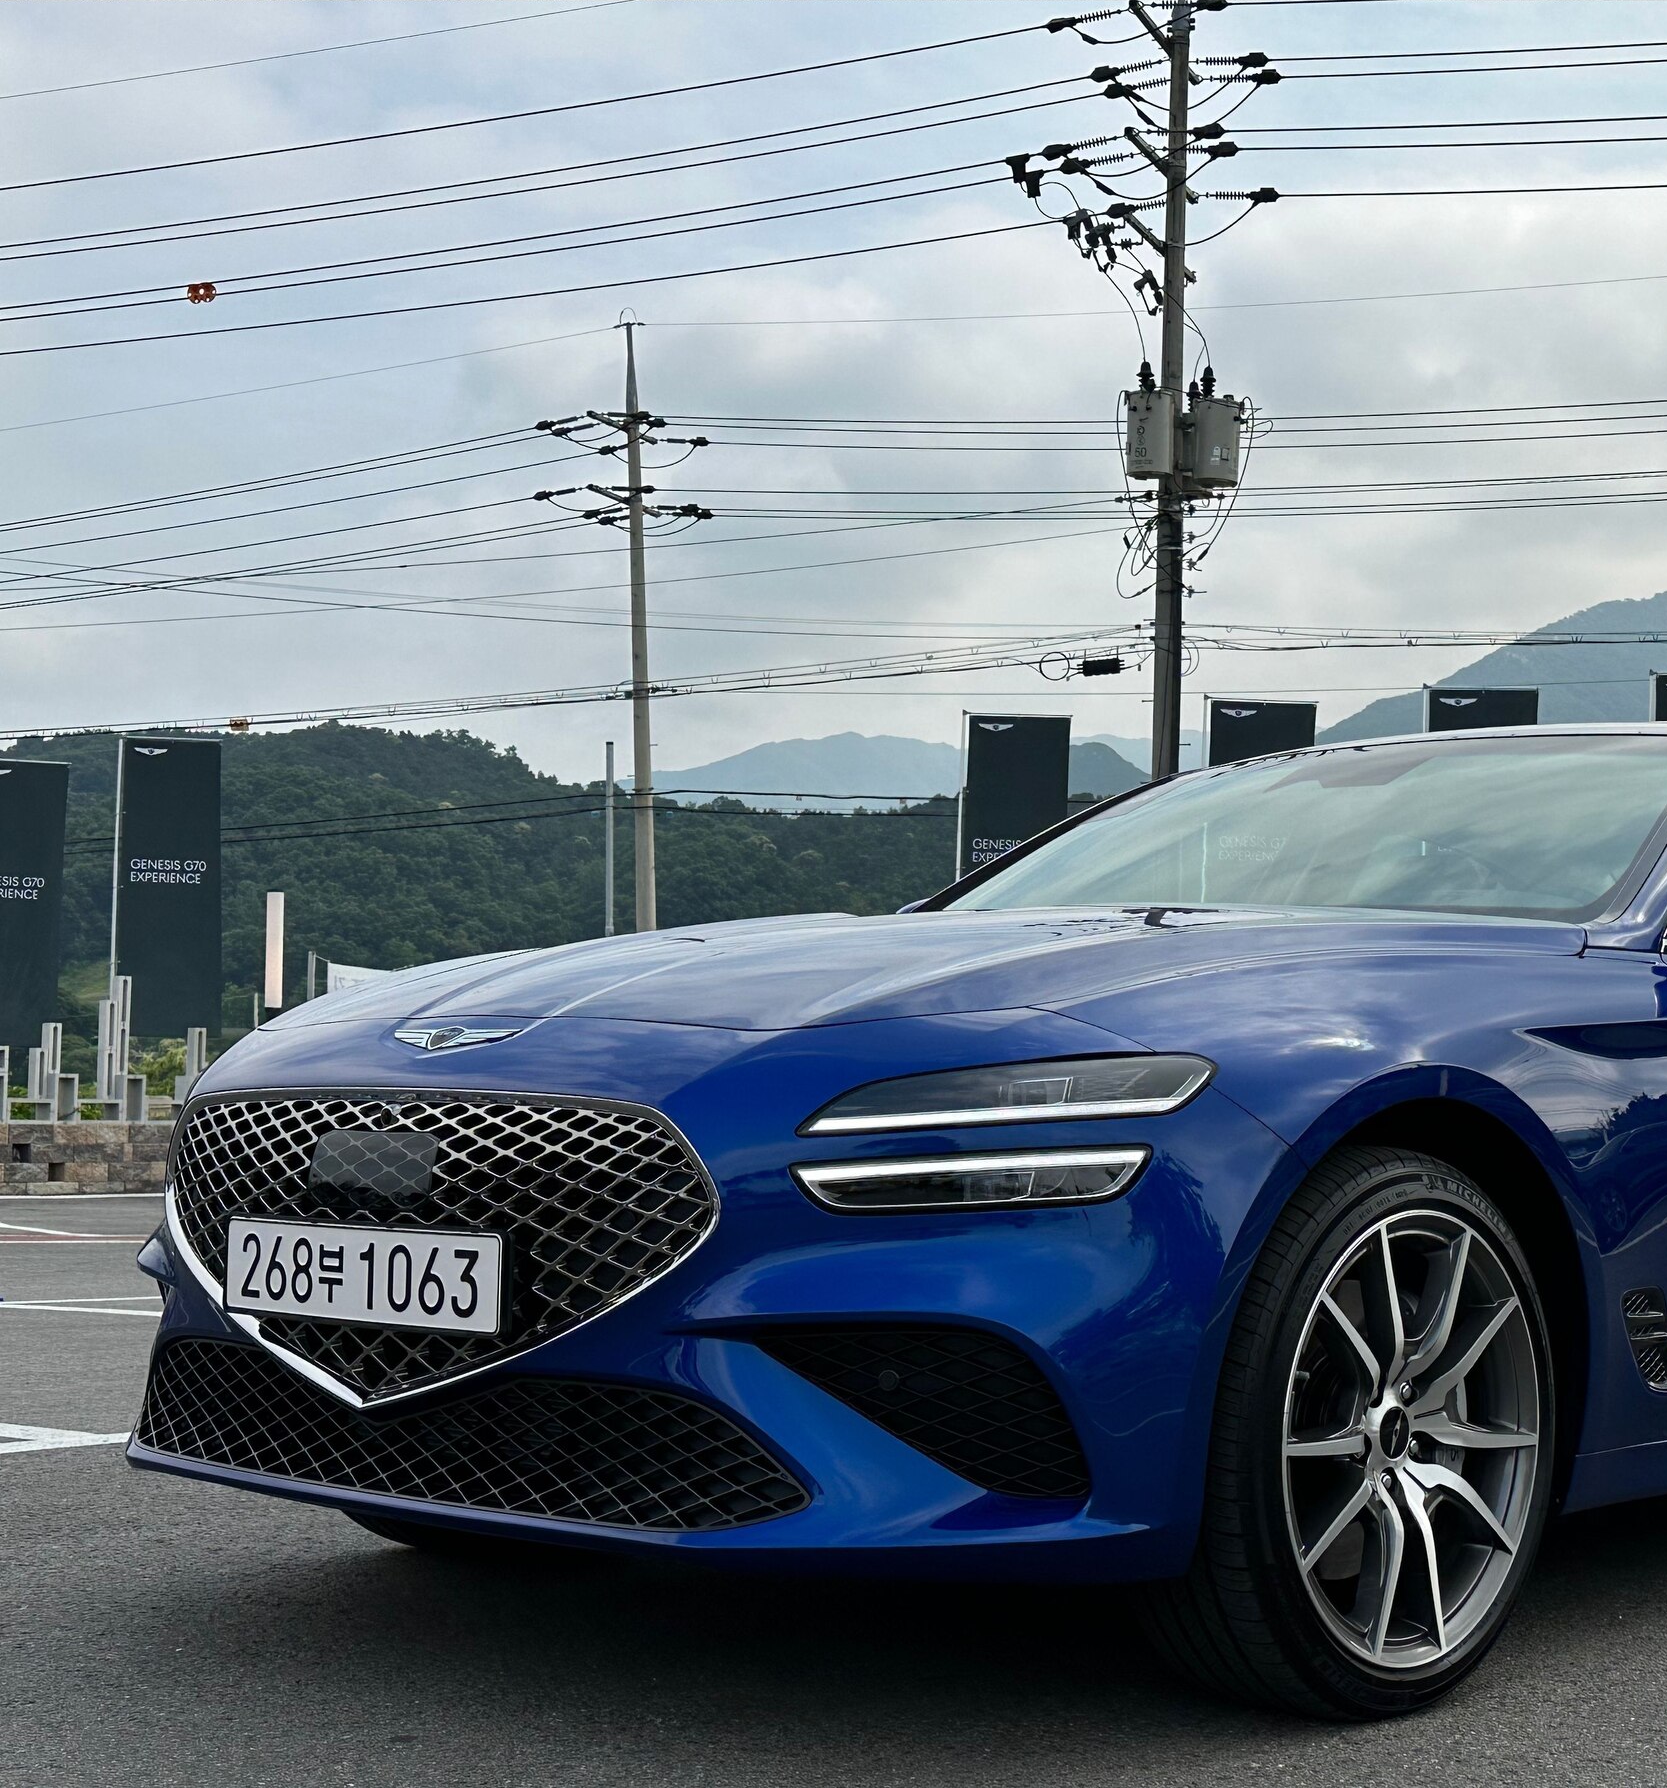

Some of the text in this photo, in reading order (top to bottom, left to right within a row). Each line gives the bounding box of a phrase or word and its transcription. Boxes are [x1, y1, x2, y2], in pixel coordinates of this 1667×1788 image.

[130, 858, 207, 872] GENESIS G70
[22, 877, 45, 889] G70
[130, 871, 201, 884] EXPERIENCE
[1446, 1179, 1508, 1234] MICHELIN
[241, 1233, 479, 1319] 268부 1063
